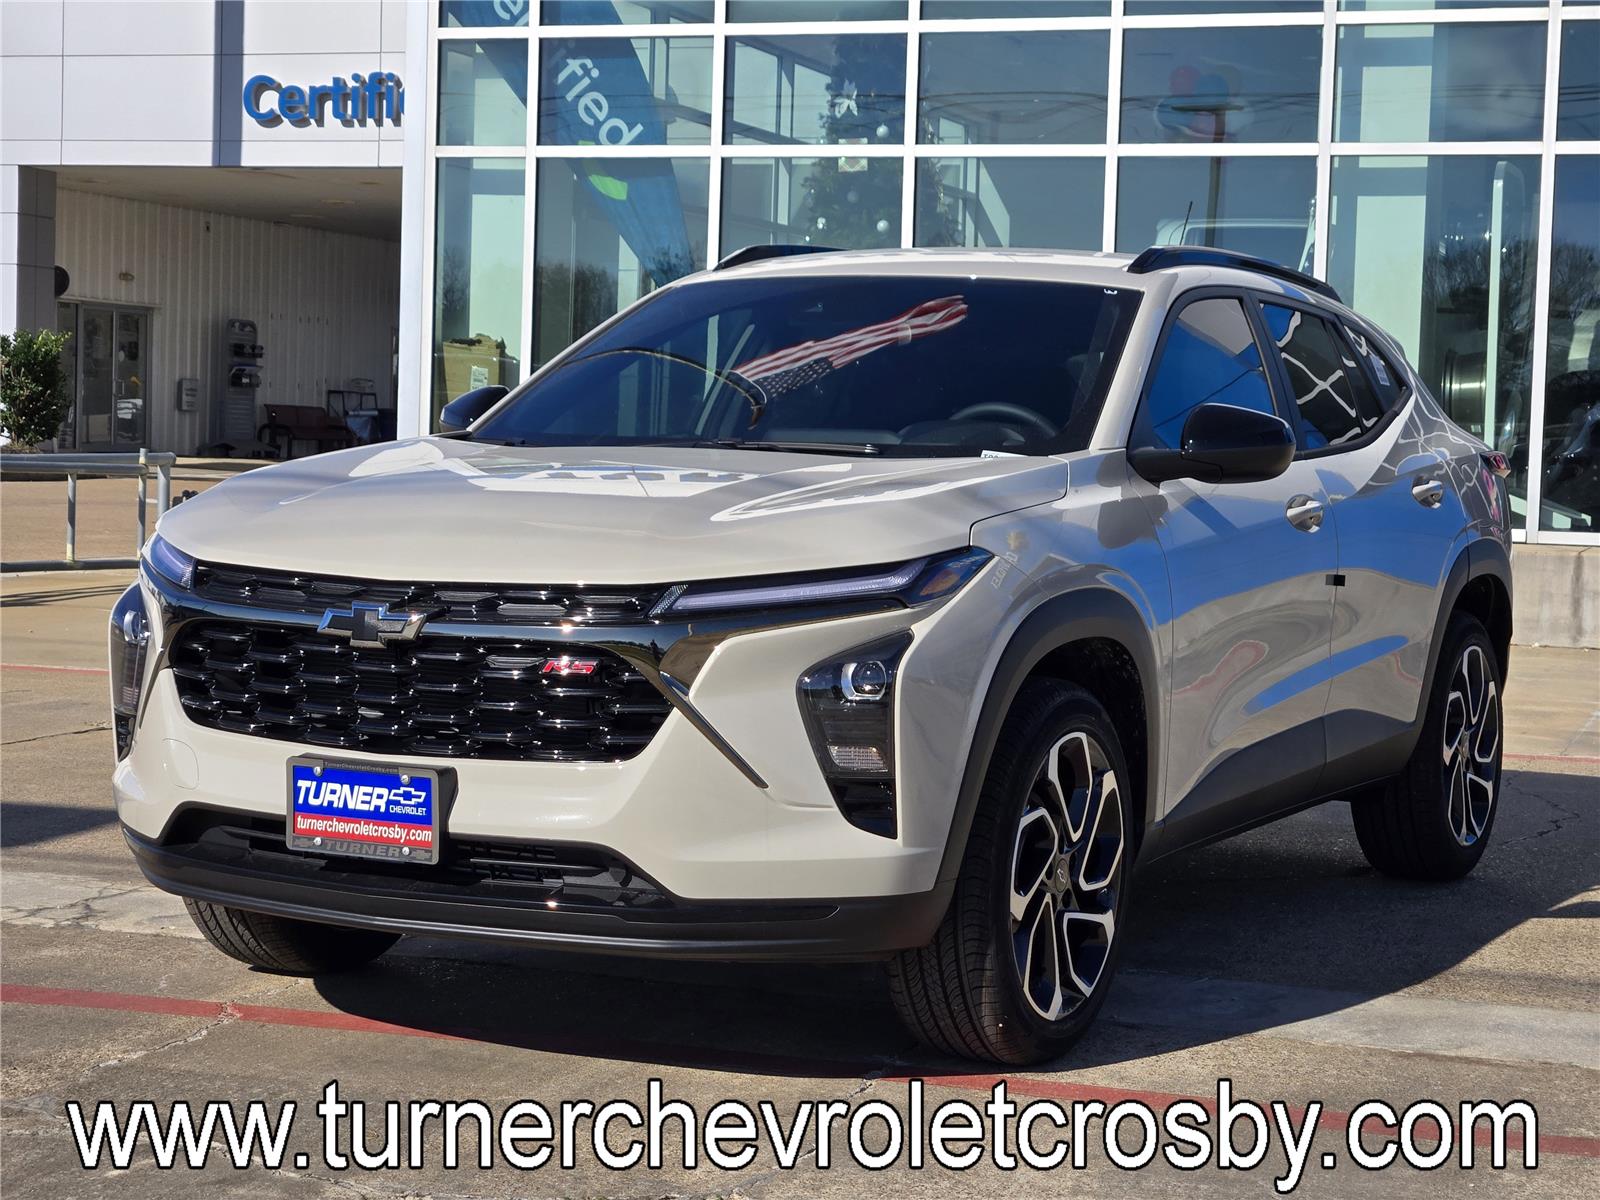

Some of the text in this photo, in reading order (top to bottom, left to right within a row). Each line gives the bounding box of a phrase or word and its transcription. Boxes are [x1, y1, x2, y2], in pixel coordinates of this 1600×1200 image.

[242, 71, 405, 125] Certifi
[542, 659, 597, 675] RS
[296, 779, 390, 813] TURNER
[389, 805, 427, 816] CHEVROLET
[296, 815, 433, 843] turnerchevroletcrosby.com
[325, 839, 400, 857] TURNER
